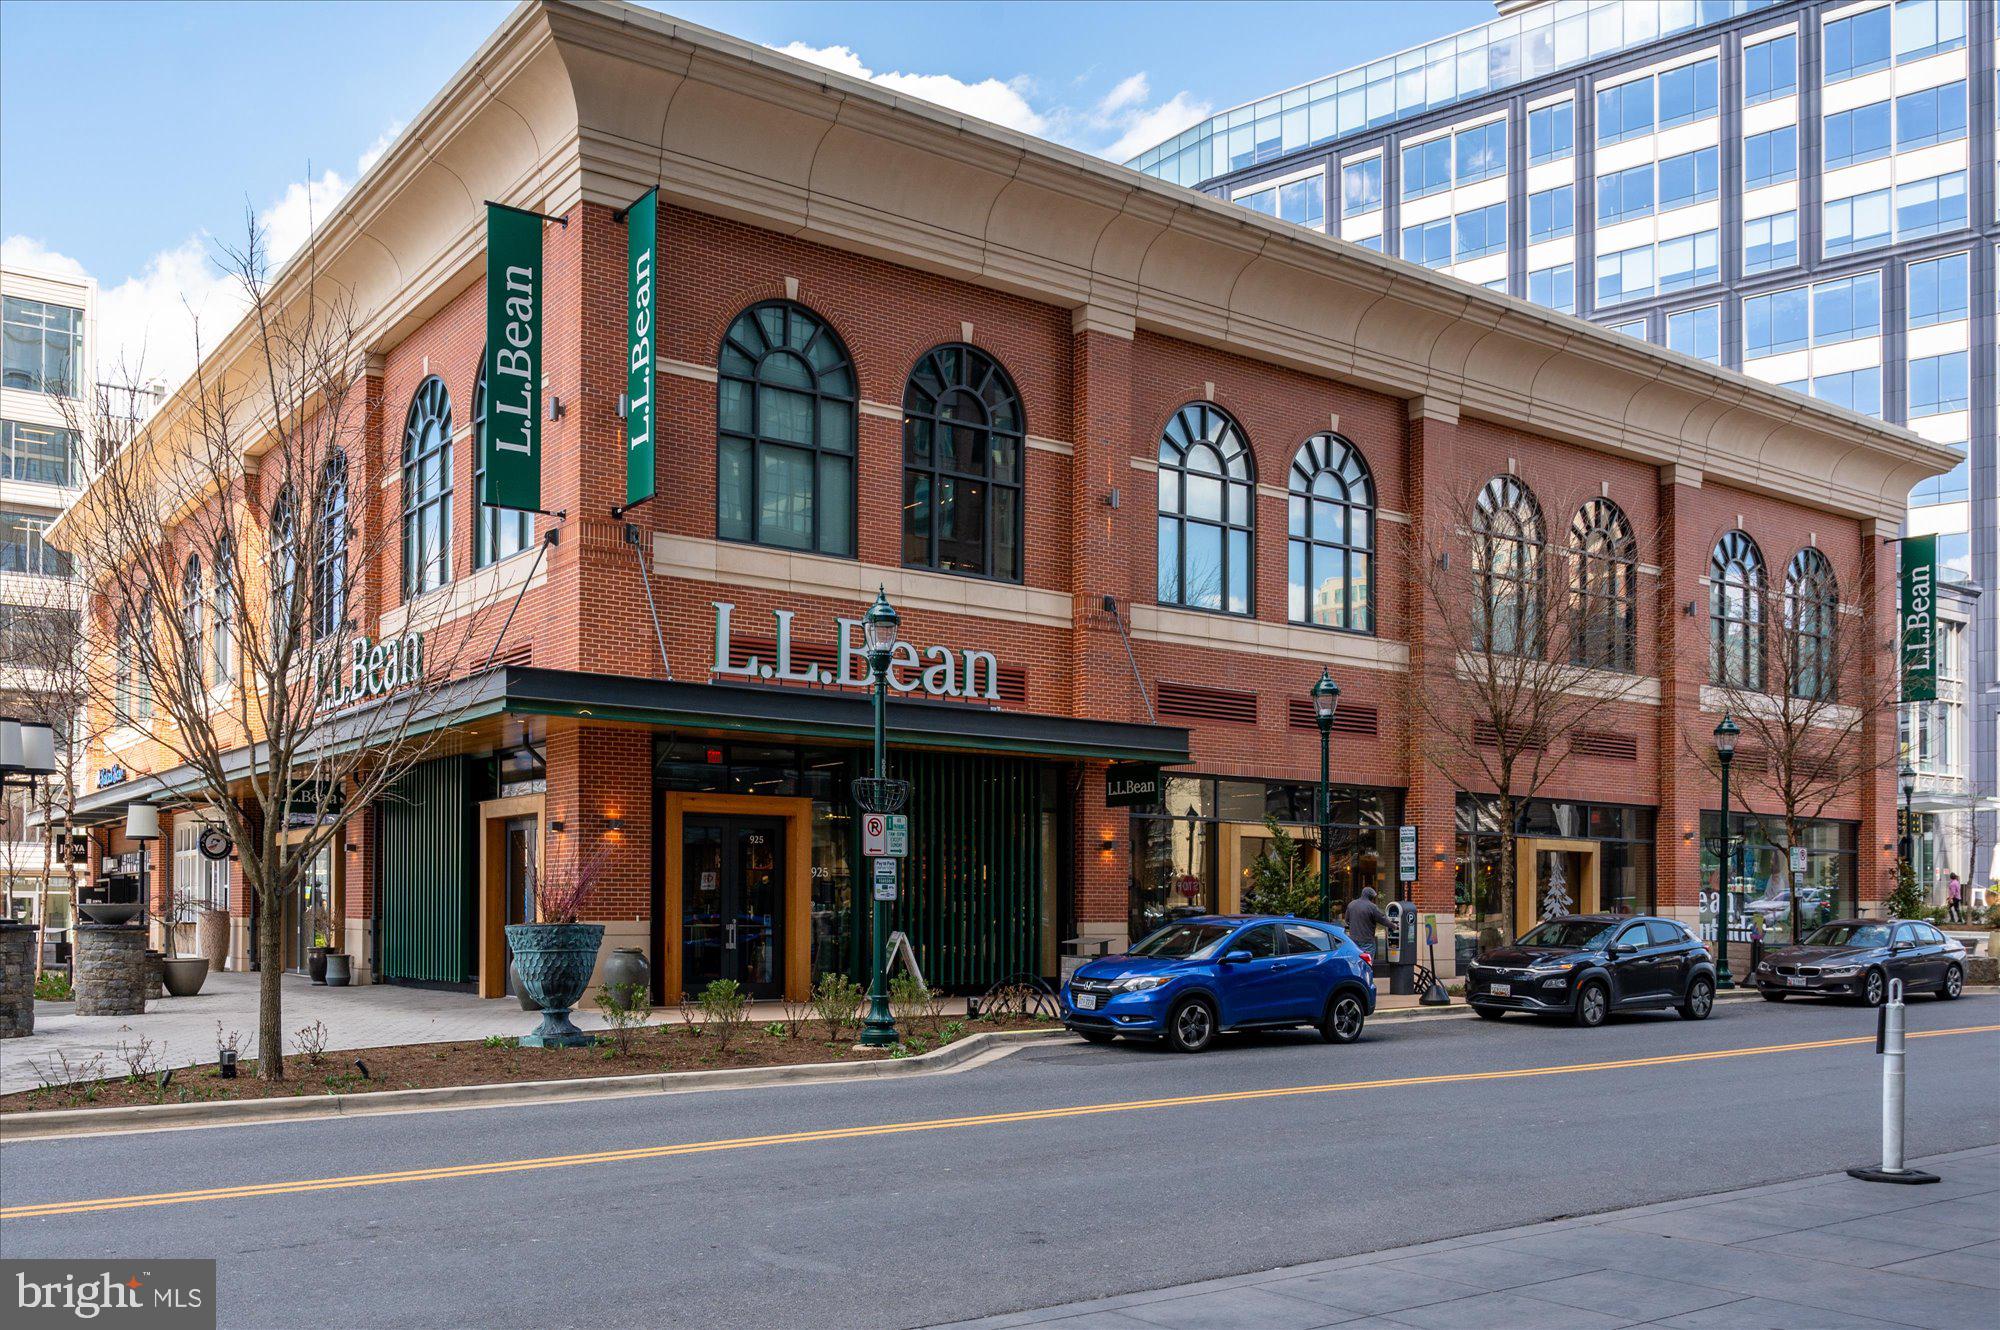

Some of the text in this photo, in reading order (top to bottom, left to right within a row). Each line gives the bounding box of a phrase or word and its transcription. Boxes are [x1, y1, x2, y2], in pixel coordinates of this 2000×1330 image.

[496, 264, 533, 457] L.L.Bean
[632, 248, 651, 450] L.L.Bean
[1906, 564, 1931, 671] L.L.Bean
[710, 601, 1000, 700] L.L.Bean
[1108, 780, 1155, 796] L.L.Bean
[60, 844, 85, 854] JYA
[749, 835, 764, 844] 925
[811, 866, 829, 878] 925
